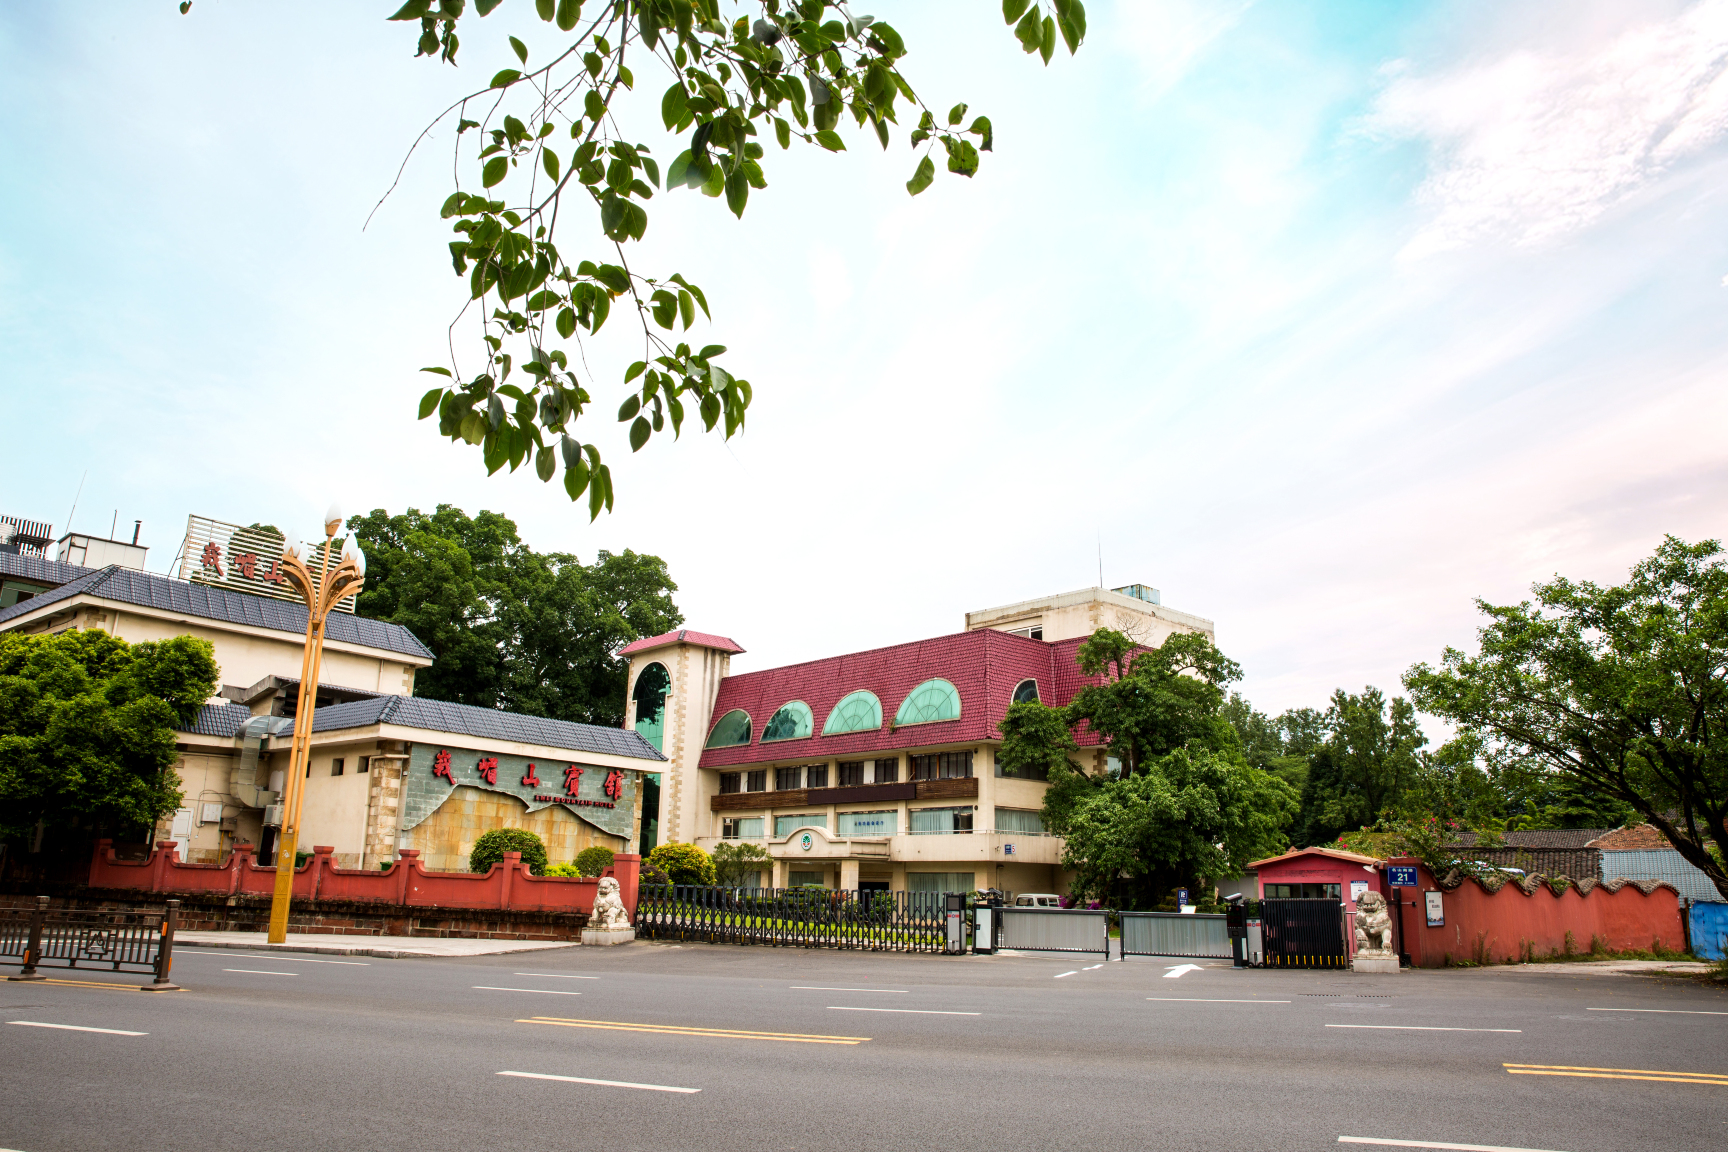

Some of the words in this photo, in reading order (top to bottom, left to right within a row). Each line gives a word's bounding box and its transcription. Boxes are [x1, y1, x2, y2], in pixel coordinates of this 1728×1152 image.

[535, 794, 553, 802] EMEI
[554, 796, 593, 806] MOUNTAIN
[594, 801, 616, 809] HOTEL
[1397, 873, 1408, 882] 21
